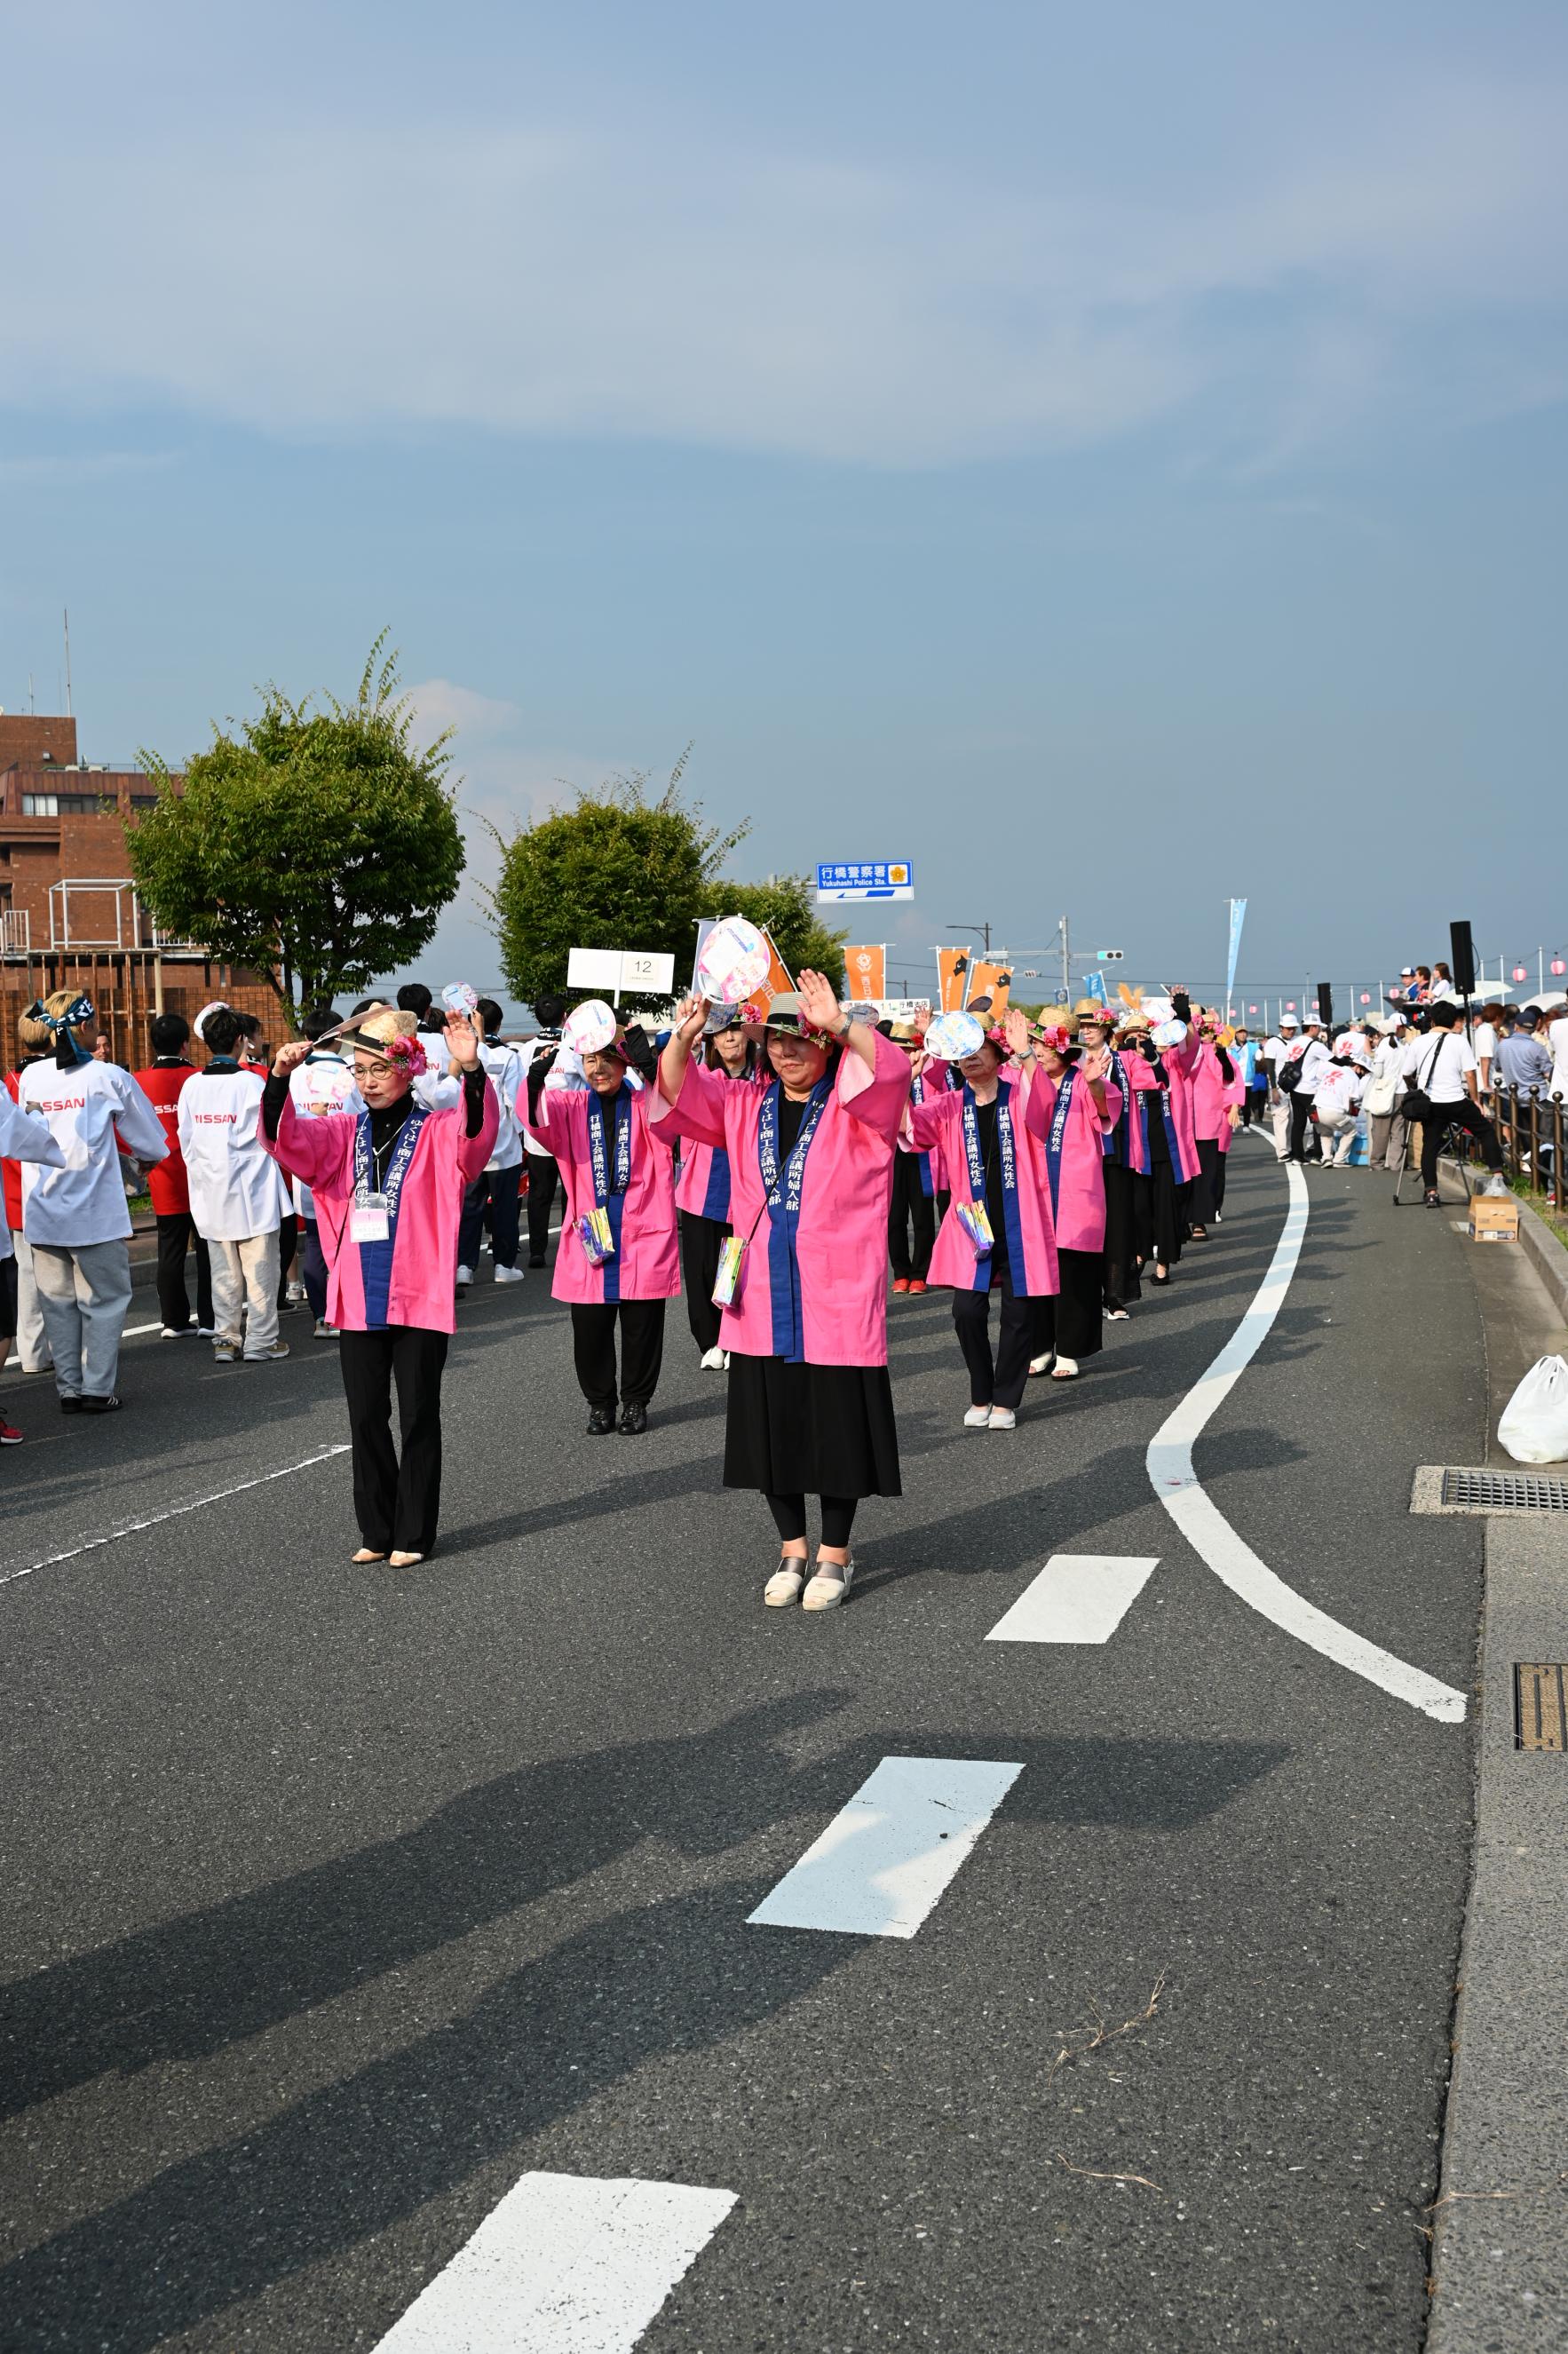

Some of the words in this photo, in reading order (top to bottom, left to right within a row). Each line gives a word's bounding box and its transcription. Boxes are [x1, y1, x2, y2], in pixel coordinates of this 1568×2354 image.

[821, 865, 886, 879] 行橋警察署
[633, 960, 652, 973] 12
[42, 1098, 85, 1112] SSAN
[590, 1114, 608, 1197] 行橋商工会議所女性会
[963, 1105, 983, 1187] 行橋商工会議所女性会
[998, 1106, 1016, 1190] 行橋商工会議所女性会
